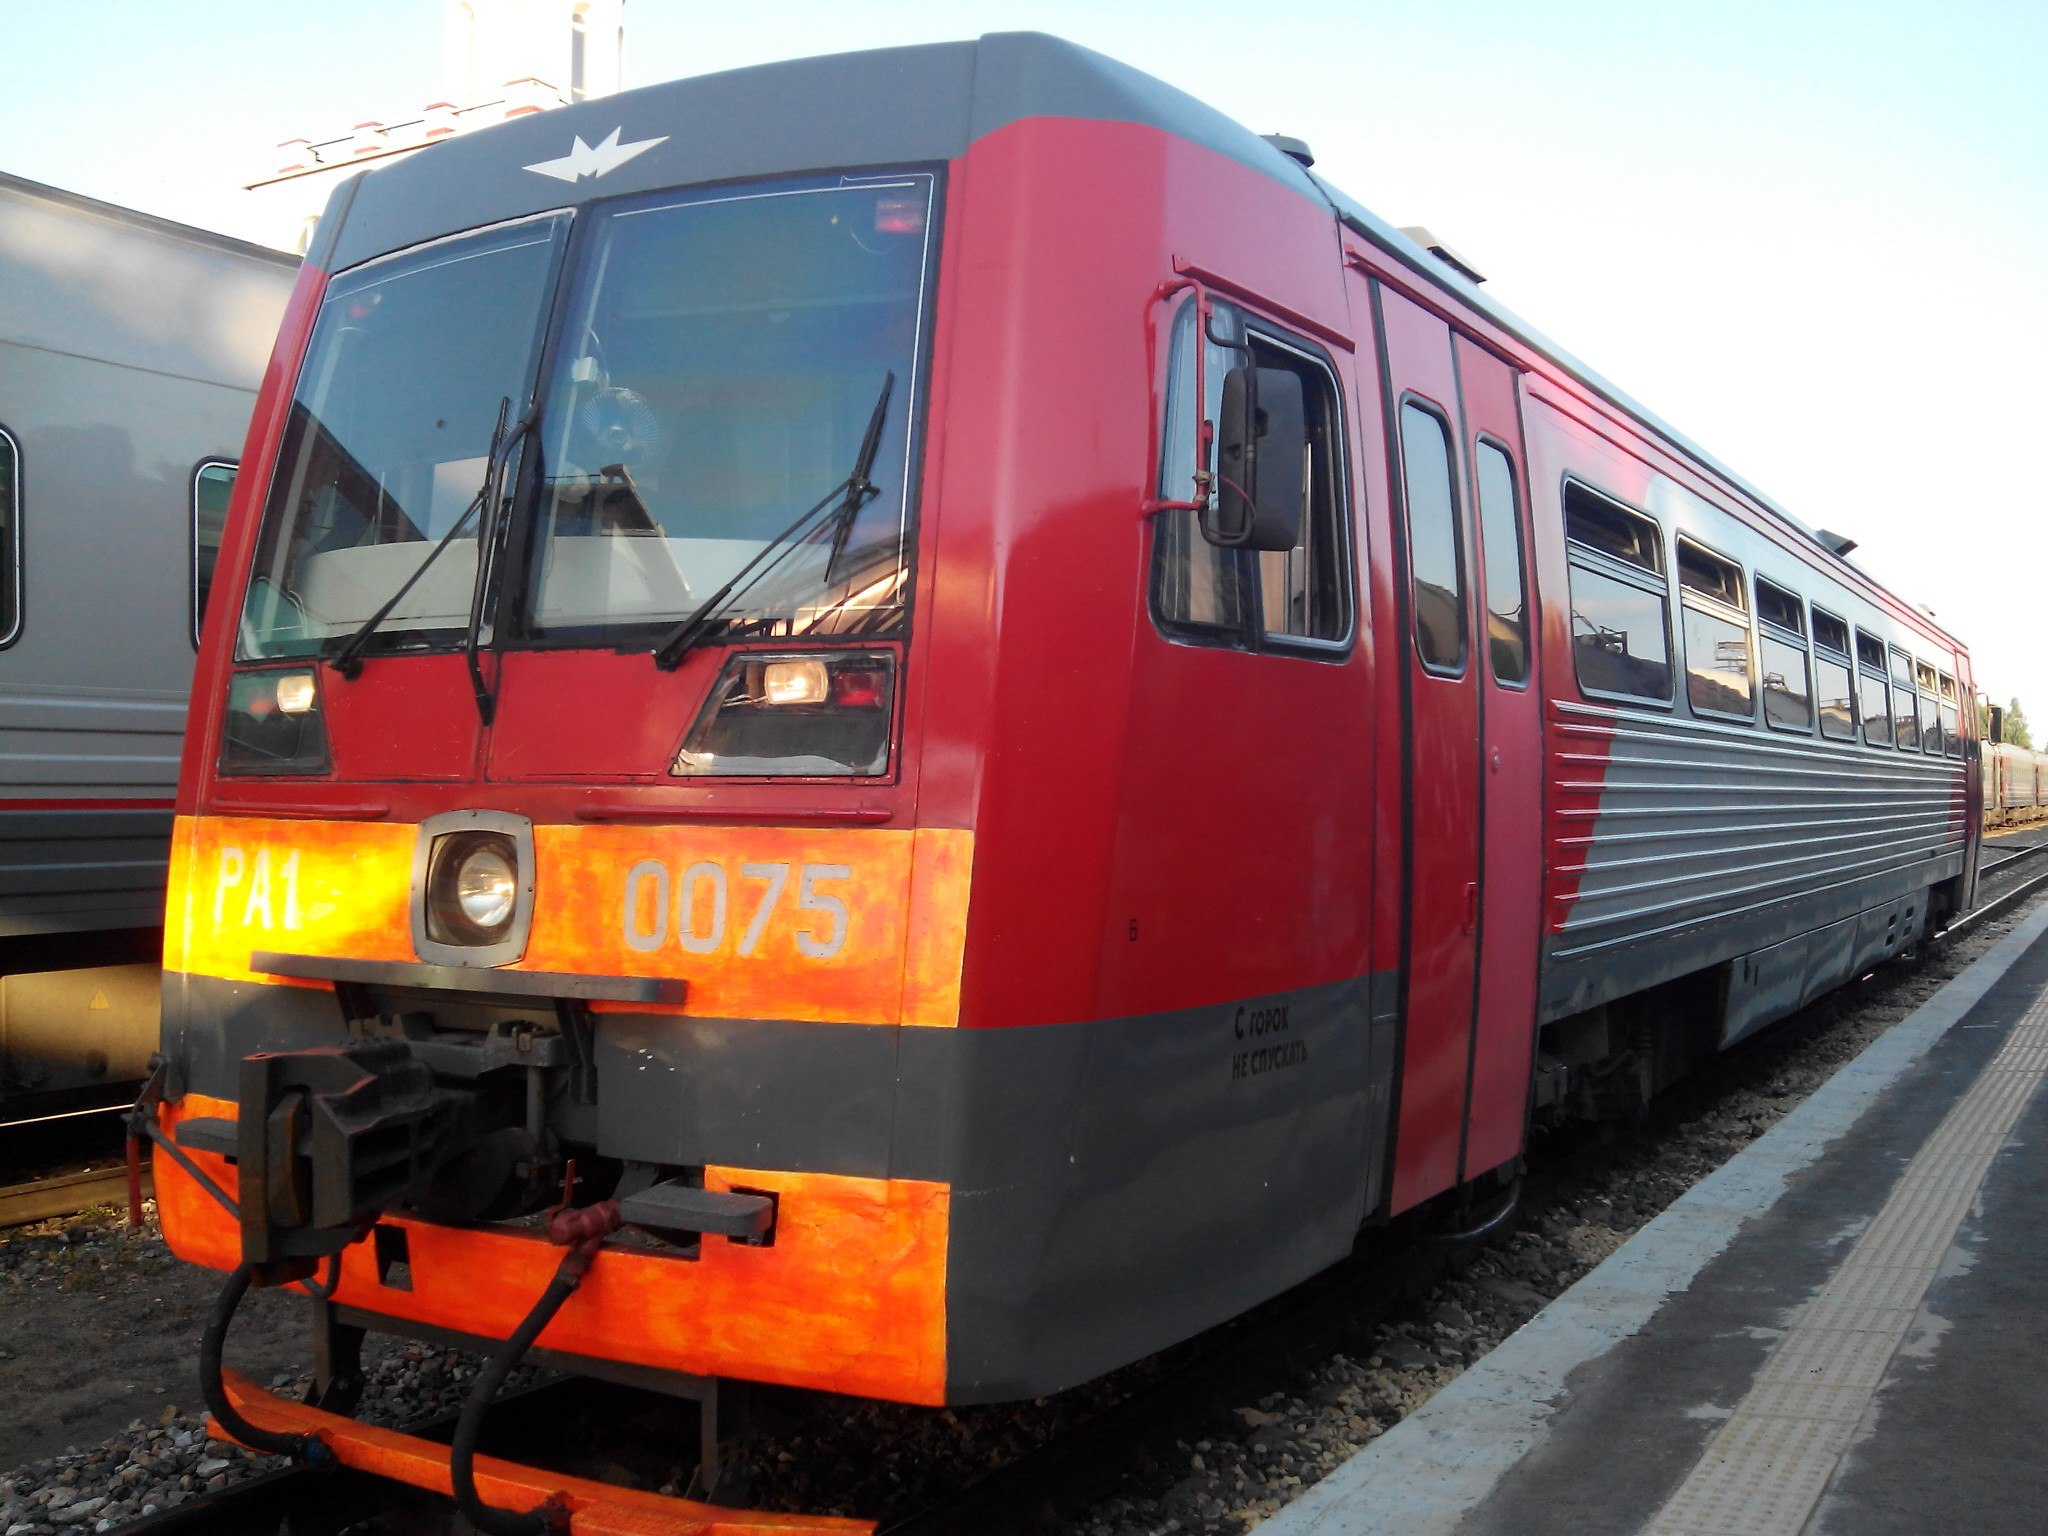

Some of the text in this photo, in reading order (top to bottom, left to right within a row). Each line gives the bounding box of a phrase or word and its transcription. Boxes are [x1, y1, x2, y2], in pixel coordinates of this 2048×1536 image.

[623, 859, 852, 958] 0075
[1232, 1040, 1308, 1080] НЕ СПУСКАТЬ
